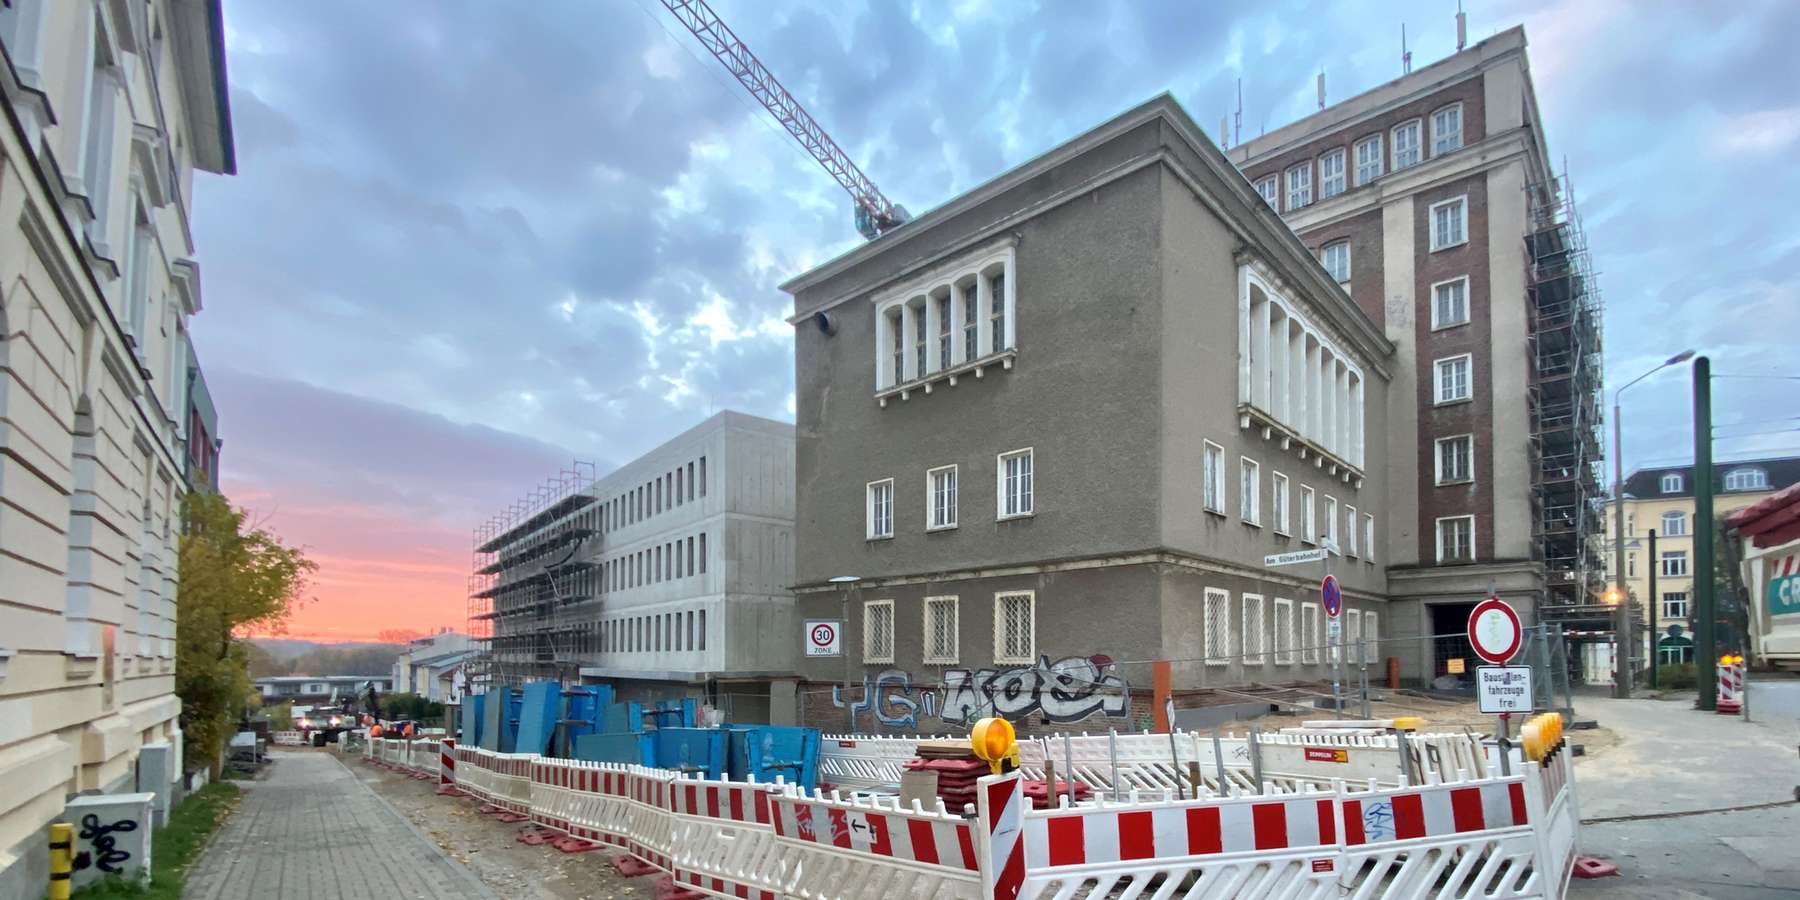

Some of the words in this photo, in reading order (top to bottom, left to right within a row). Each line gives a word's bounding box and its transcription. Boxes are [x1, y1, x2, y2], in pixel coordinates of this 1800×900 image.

[816, 630, 830, 641] 30
[1488, 685, 1525, 697] fahrzeuge
[1499, 697, 1517, 708] frei
